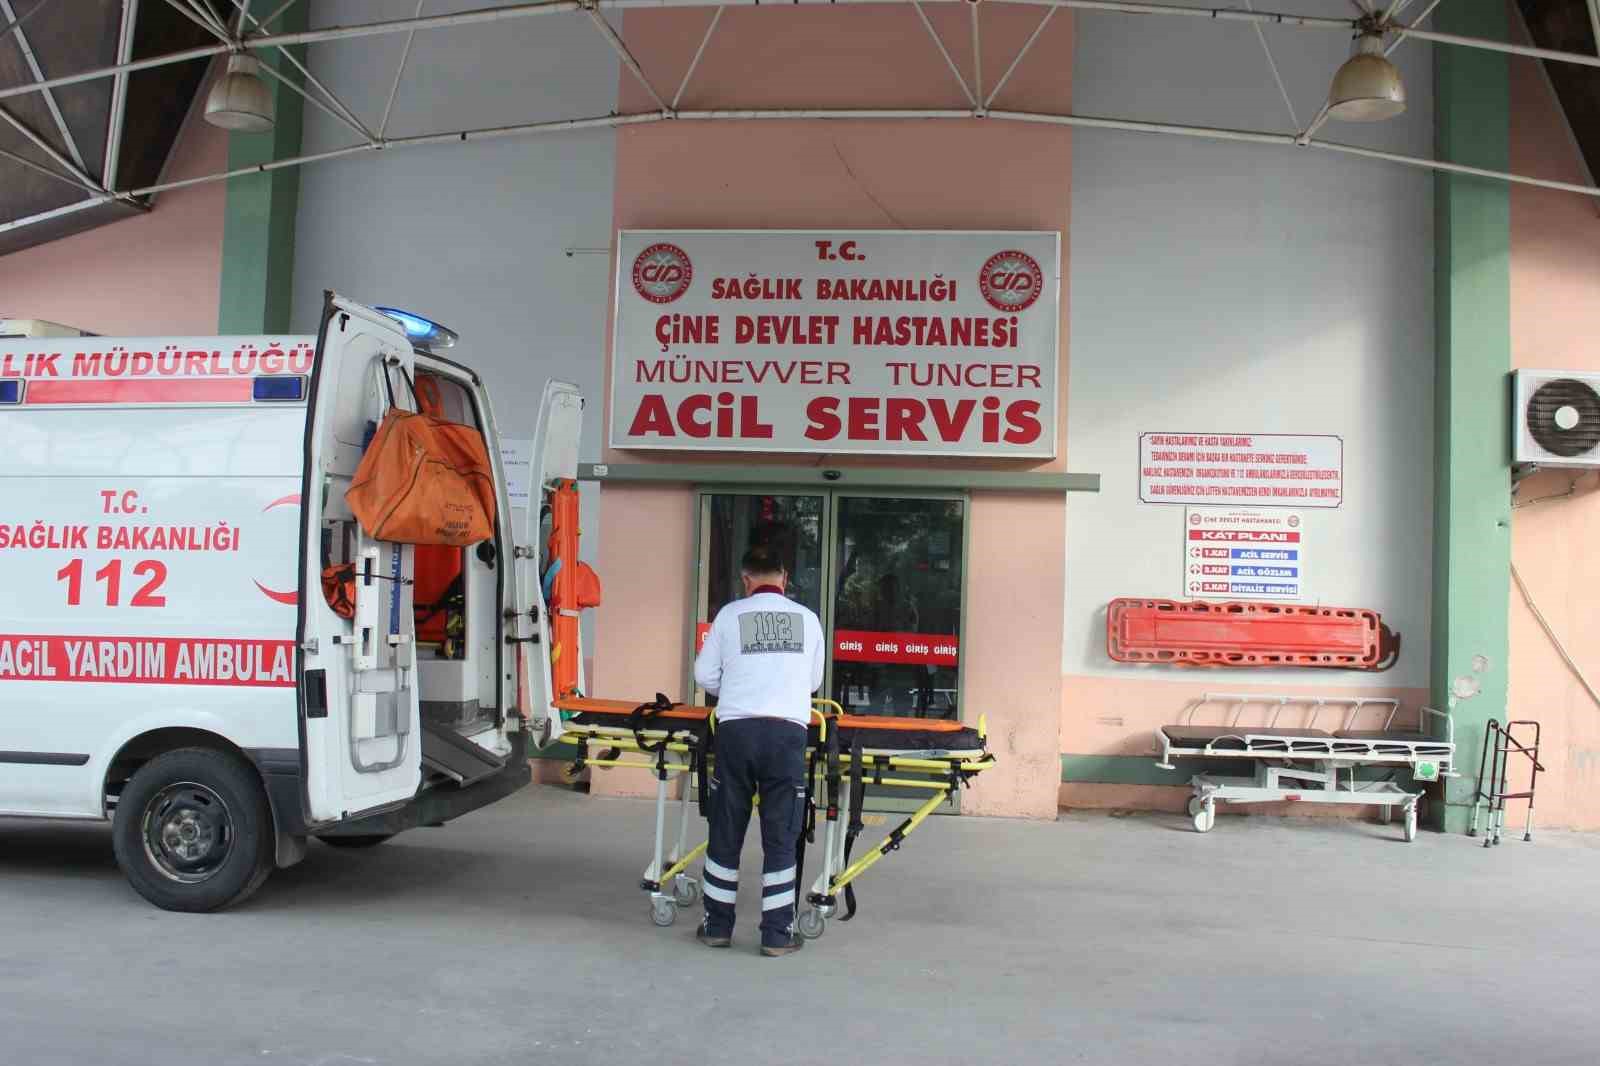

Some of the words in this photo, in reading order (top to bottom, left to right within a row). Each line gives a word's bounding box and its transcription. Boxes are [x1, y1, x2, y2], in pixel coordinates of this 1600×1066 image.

[816, 241, 866, 261] T.C.
[712, 273, 803, 301] SAĞLIK
[816, 274, 957, 302] BAKANLIĞI
[735, 315, 840, 345] DEVLET
[72, 342, 314, 377] MÜDÜRLÜĞÜ
[635, 355, 851, 385] MÜNEVVER
[886, 362, 1042, 388] TUNCER
[100, 490, 148, 514] T.C.
[0, 520, 88, 549] SAĞLIK
[96, 522, 240, 551] BAKANLIĞI
[1201, 531, 1235, 540] KAT
[1237, 532, 1288, 541] PLANI
[56, 558, 168, 608] 112
[754, 611, 793, 641] 112
[64, 641, 165, 679] YARDIM
